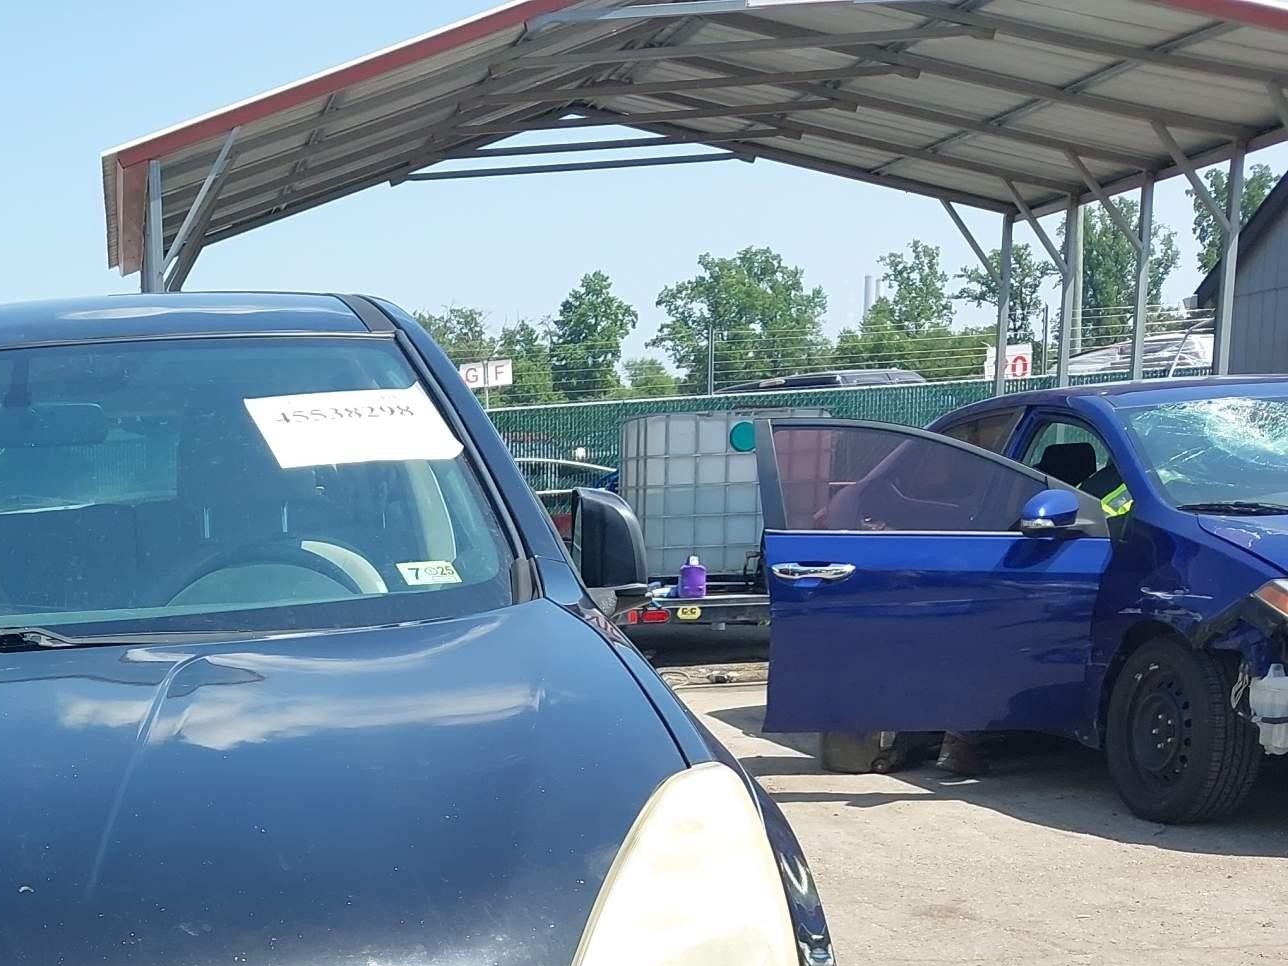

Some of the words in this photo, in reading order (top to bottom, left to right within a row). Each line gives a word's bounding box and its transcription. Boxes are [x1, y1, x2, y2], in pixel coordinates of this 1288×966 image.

[465, 367, 479, 383] G
[495, 364, 505, 381] F
[275, 404, 414, 423] 45538298
[407, 567, 420, 580] 7
[436, 565, 455, 576] 25
